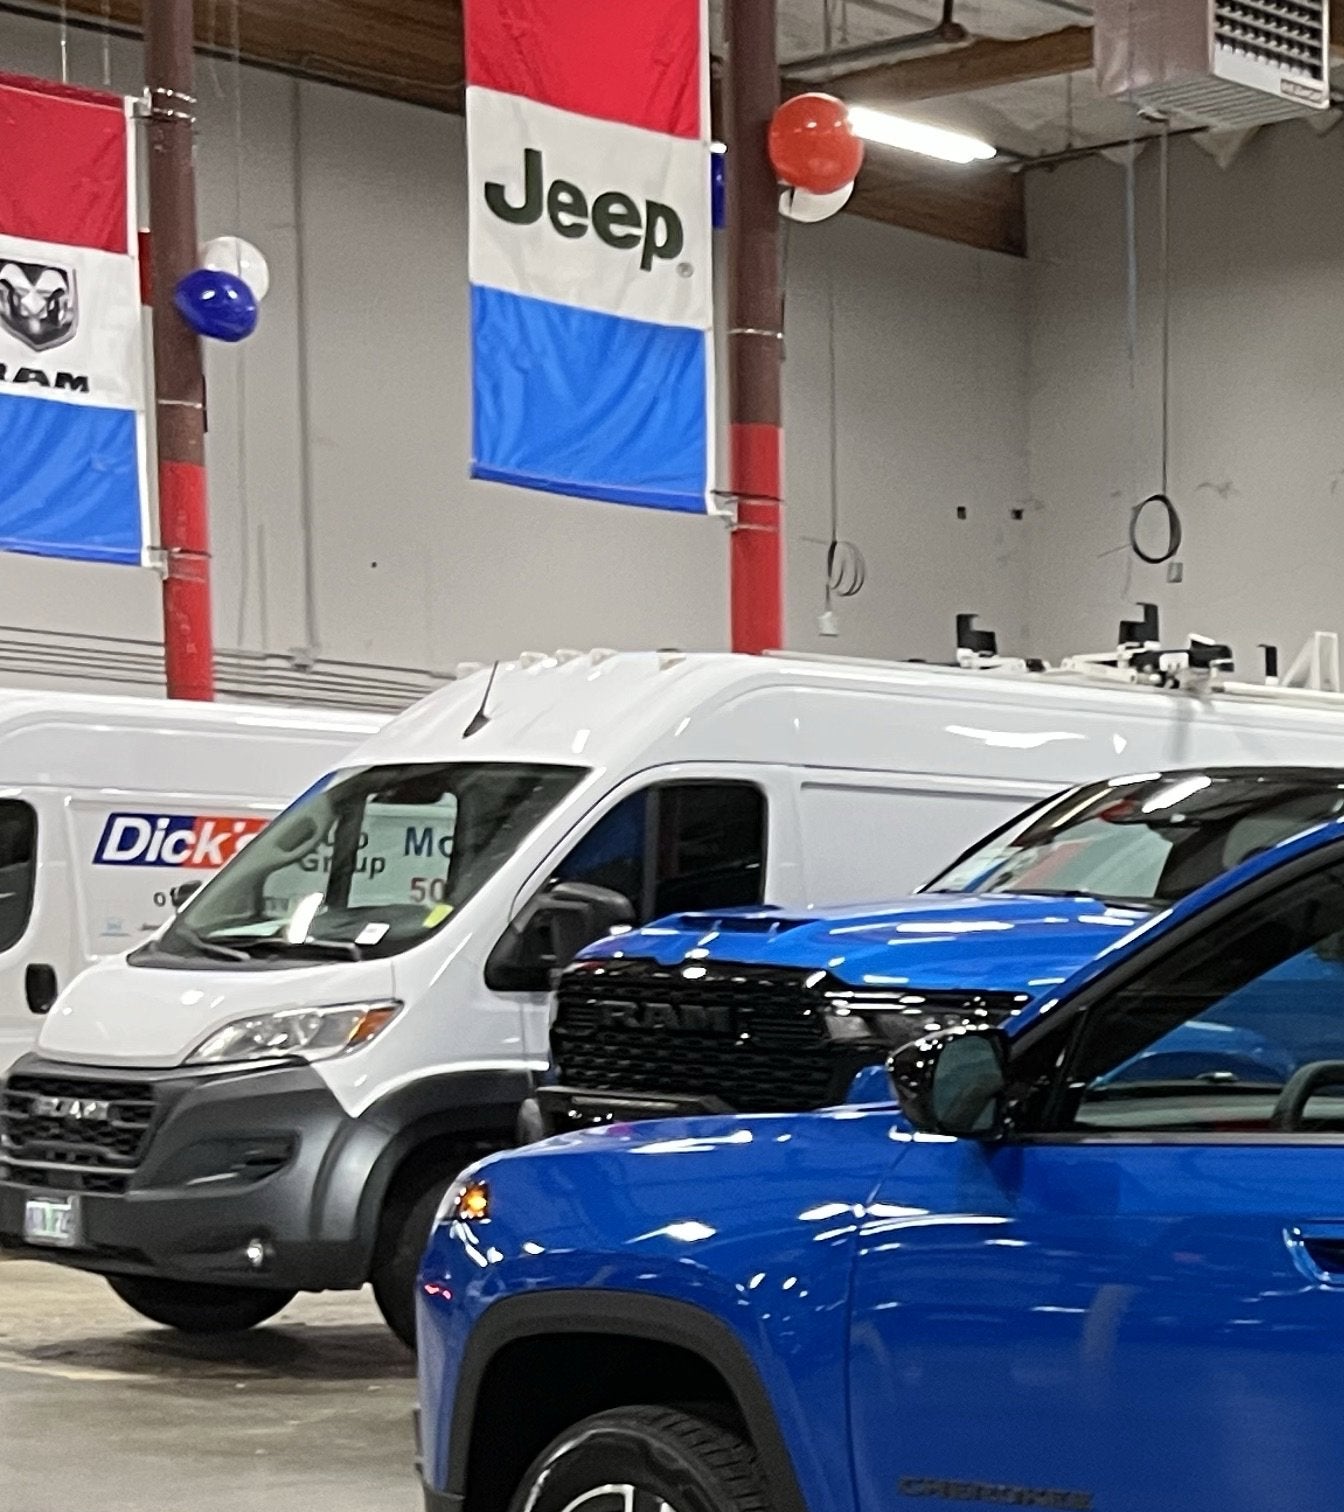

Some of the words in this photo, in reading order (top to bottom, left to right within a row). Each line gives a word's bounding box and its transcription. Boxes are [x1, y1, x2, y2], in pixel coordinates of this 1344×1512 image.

[485, 148, 683, 272] Jeep
[0, 363, 89, 392] AM
[301, 855, 386, 880] Grup
